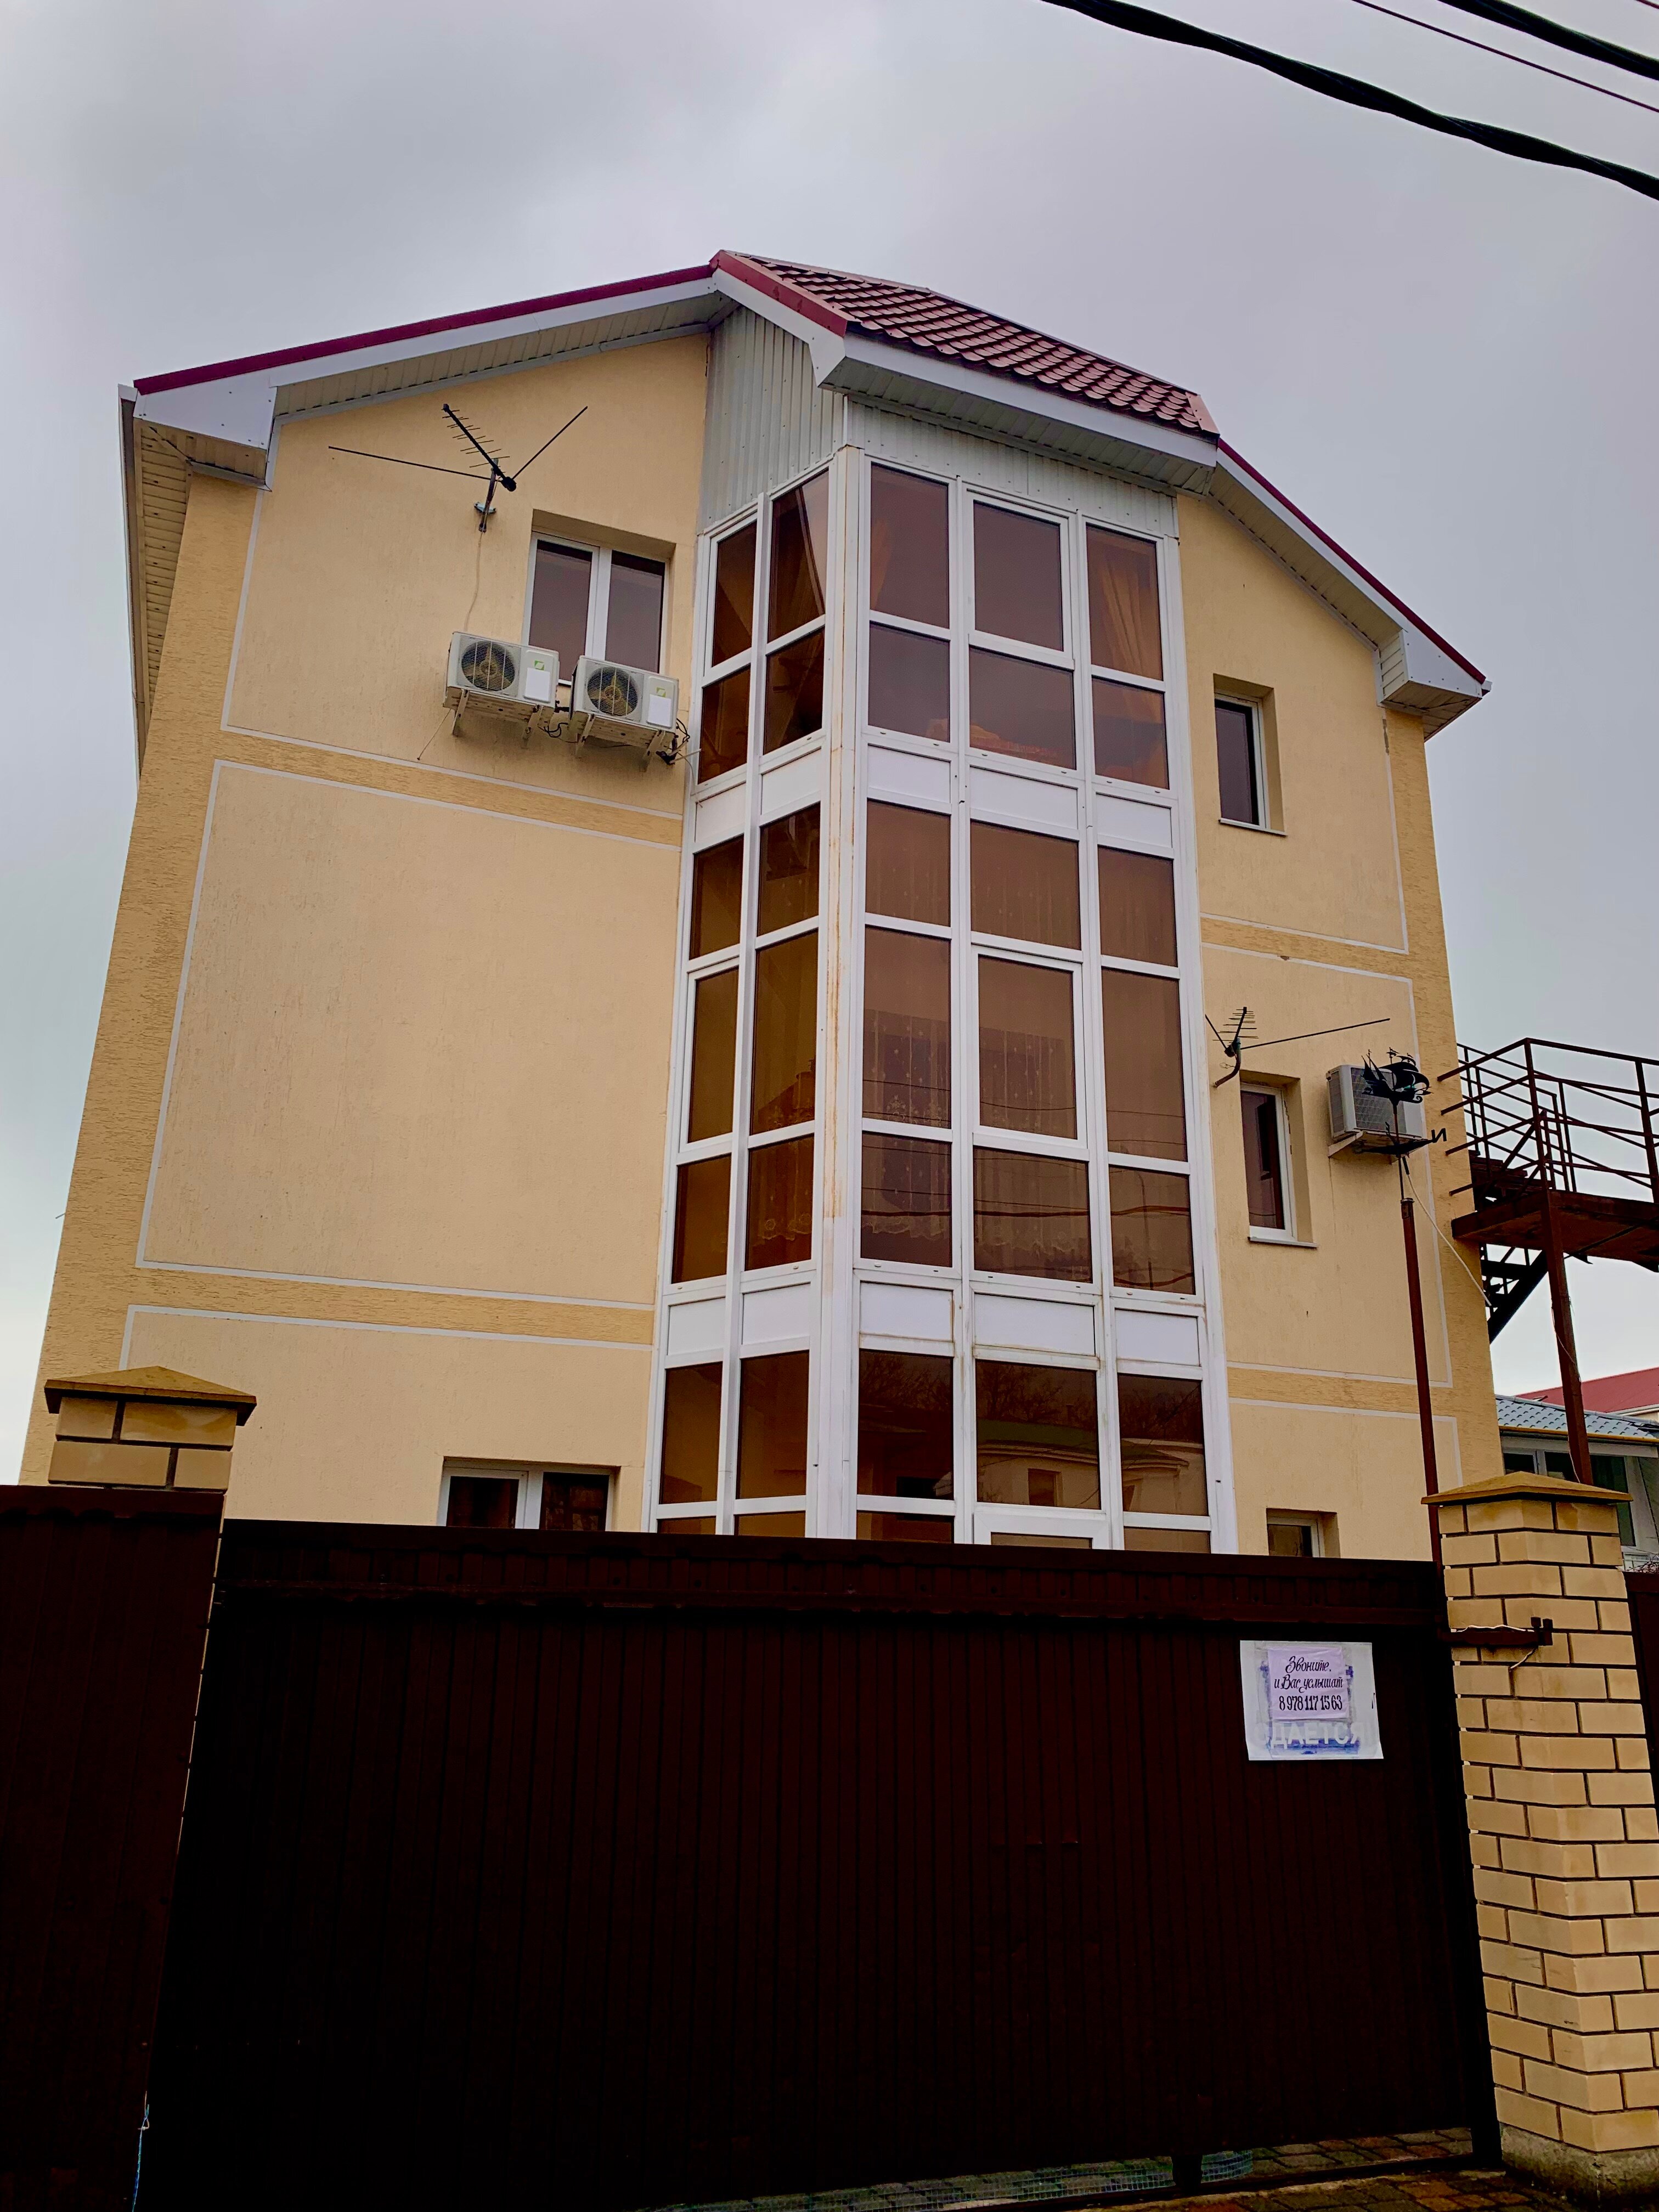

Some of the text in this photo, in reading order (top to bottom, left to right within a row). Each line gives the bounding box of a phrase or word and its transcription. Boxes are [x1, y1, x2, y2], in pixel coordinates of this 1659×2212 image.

[1274, 1674, 1343, 1694] и Вас услышат
[1279, 1695, 1342, 1711] 8 978 117 15 63
